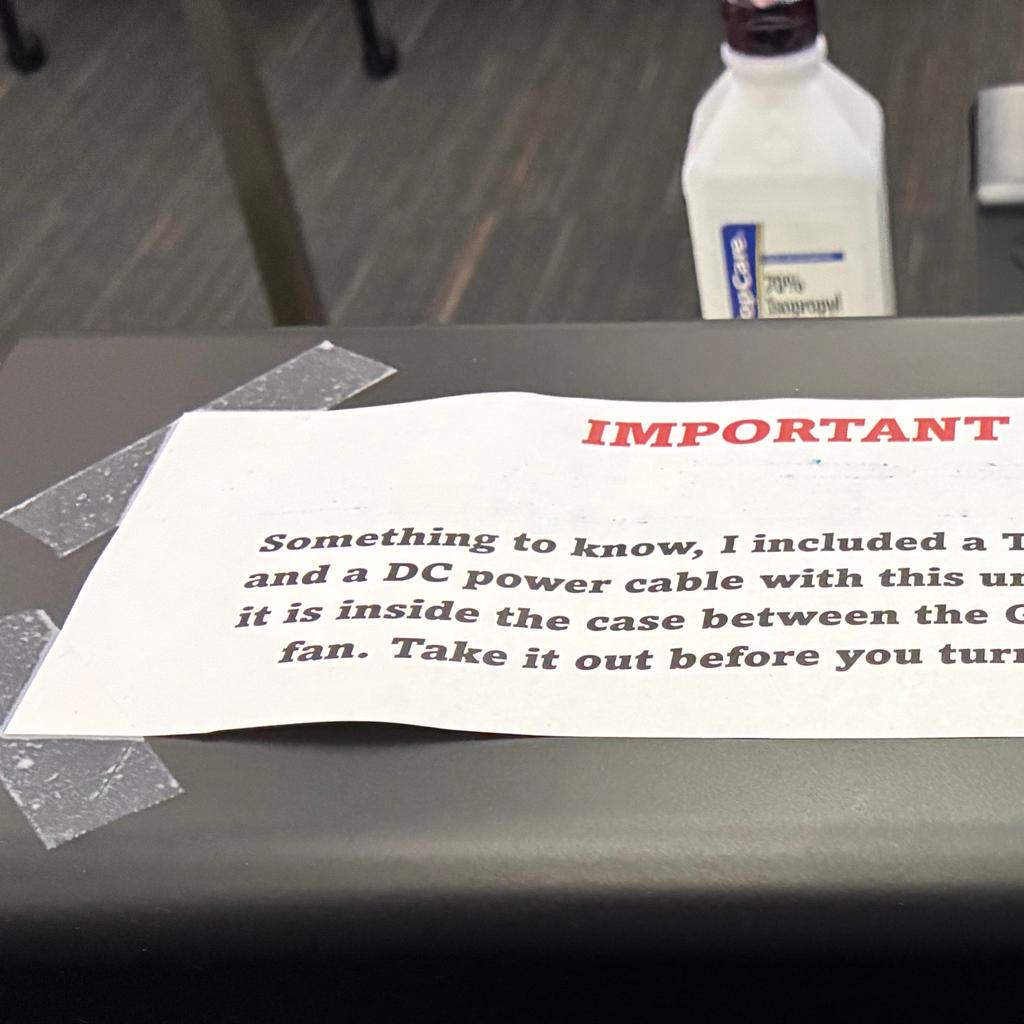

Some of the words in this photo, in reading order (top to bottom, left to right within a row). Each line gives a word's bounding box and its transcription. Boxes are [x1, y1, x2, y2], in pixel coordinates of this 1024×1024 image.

[730, 235, 756, 319] opCare
[582, 417, 1009, 447] IMPORTANT
[260, 528, 499, 553] Something
[514, 534, 556, 553] to
[571, 538, 703, 559] know,
[721, 536, 738, 553] I
[752, 532, 946, 552] included
[963, 537, 986, 551] a
[245, 565, 330, 588] and
[343, 568, 367, 582] a
[383, 563, 452, 582] DC
[463, 571, 611, 593] power
[625, 571, 743, 593] cable
[760, 568, 863, 589] with
[879, 567, 963, 587] this
[235, 607, 271, 627] it
[283, 603, 322, 623] is
[336, 599, 479, 622] inside
[497, 608, 569, 630] the
[587, 615, 684, 631] case
[702, 608, 899, 629] between
[915, 604, 988, 624] the
[279, 641, 368, 663] fan.
[392, 638, 507, 665] Take
[523, 648, 559, 669] it
[575, 650, 653, 670] out
[670, 646, 819, 669] before
[836, 649, 922, 671] you
